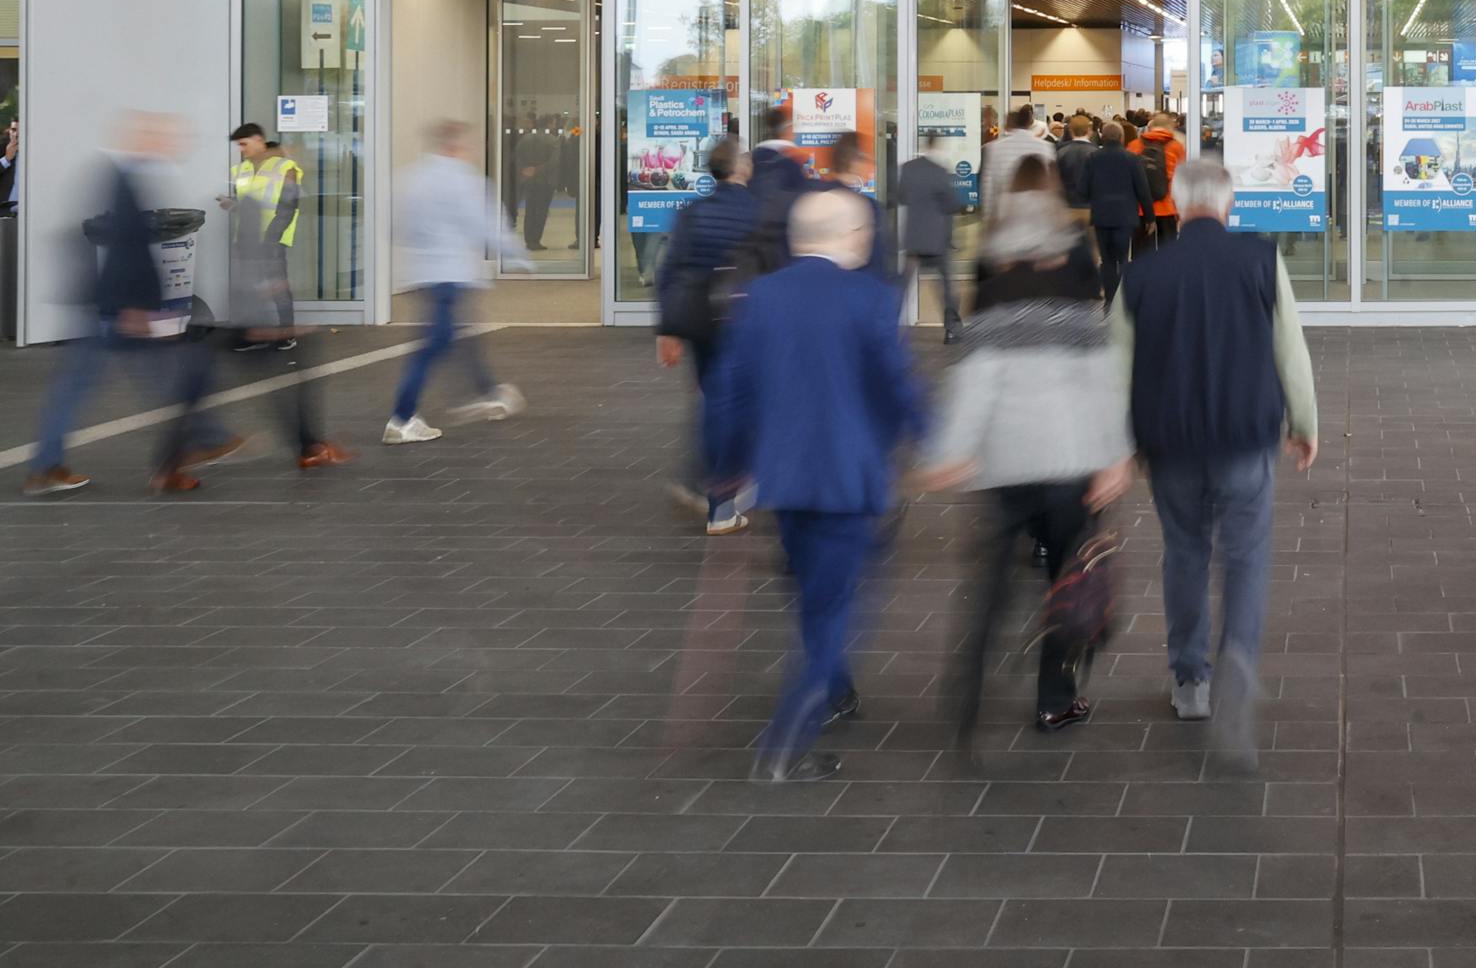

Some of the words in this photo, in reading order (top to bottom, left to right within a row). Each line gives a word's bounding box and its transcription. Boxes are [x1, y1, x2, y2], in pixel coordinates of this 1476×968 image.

[1074, 77, 1119, 88] Information
[649, 100, 685, 109] Plastics
[1405, 99, 1464, 112] ArabPlast
[657, 108, 706, 117] Petrochem
[638, 200, 666, 209] MEMBER
[666, 200, 674, 208] OF
[1234, 200, 1262, 208] MEMBER
[1263, 200, 1272, 208] OF
[1283, 200, 1314, 208] ALLIANCE
[1394, 199, 1422, 207] MEMBER
[1422, 199, 1431, 207] OF
[1442, 199, 1473, 207] ALLIANCE
